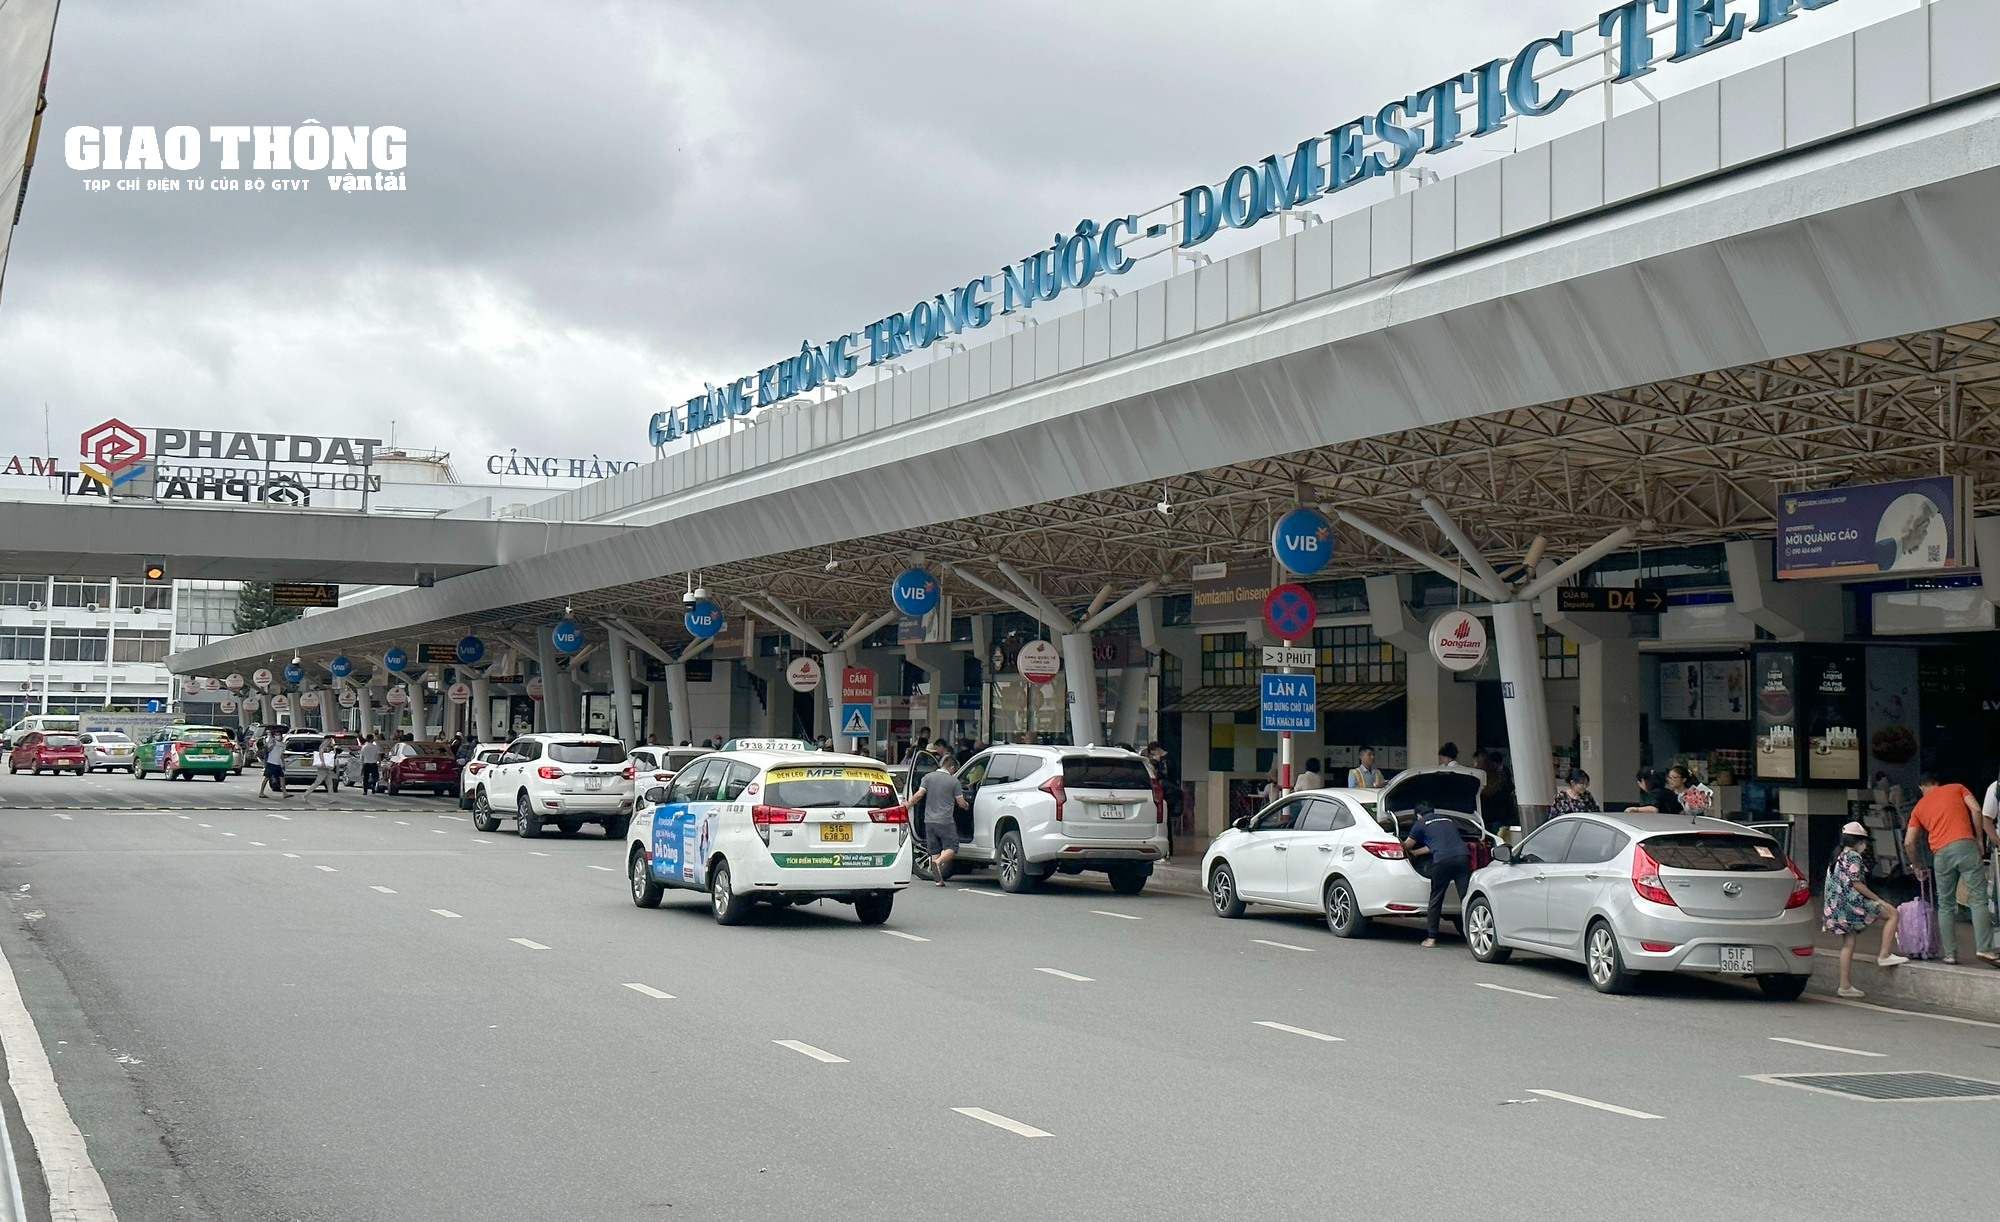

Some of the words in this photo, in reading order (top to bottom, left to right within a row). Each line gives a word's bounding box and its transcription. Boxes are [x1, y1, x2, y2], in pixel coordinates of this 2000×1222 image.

[649, 406, 684, 447] GA
[686, 376, 753, 434] HÀNG
[757, 332, 858, 407] KHÔNG
[865, 275, 993, 366] TRONG
[1001, 214, 1136, 315] NƯỚC
[1179, 30, 1573, 248] DOMESTIC
[156, 429, 382, 466] PHATDAT
[487, 449, 558, 477] CẢNG
[155, 464, 381, 492] CORPORATION
[1285, 534, 1318, 552] VIB
[1785, 532, 1802, 545] MỜI
[1804, 530, 1836, 545] QUẢNG
[1838, 528, 1858, 540] CÁO
[901, 586, 925, 600] VIB
[1194, 588, 1234, 606] Homtamin
[1608, 590, 1635, 609] D4
[691, 616, 712, 626] VIB
[557, 633, 575, 642] VIB
[1440, 638, 1481, 648] Dongtam
[459, 647, 476, 655] VIB
[1277, 652, 1283, 663] 3
[1286, 650, 1312, 664] PHÚT
[849, 672, 867, 684] CẤM
[1823, 672, 1842, 680] Legend
[843, 687, 854, 697] ĐÓN
[854, 687, 872, 697] KHÁCH
[1269, 679, 1294, 696] LÀN
[1298, 683, 1308, 697] A
[806, 769, 843, 778] MPE
[833, 855, 840, 866] 2
[1728, 948, 1746, 960] 51F
